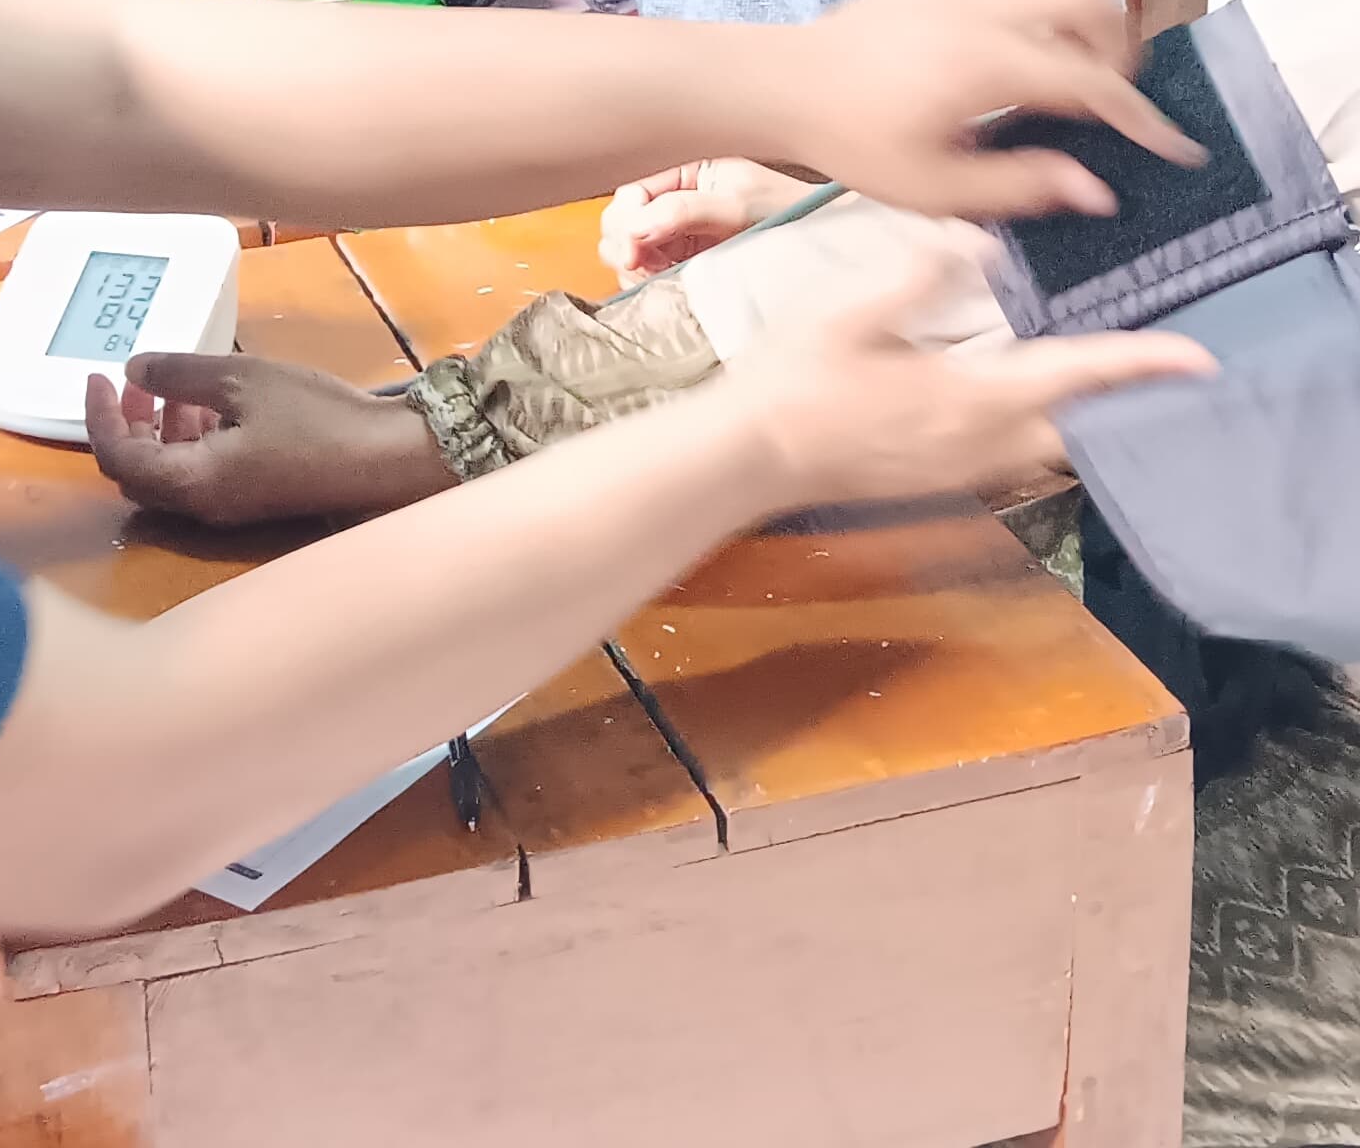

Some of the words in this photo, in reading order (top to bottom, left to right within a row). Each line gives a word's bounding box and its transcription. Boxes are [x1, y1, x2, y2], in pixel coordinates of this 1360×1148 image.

[97, 273, 161, 301] 133
[95, 303, 149, 330] 84
[104, 334, 136, 352] 84
